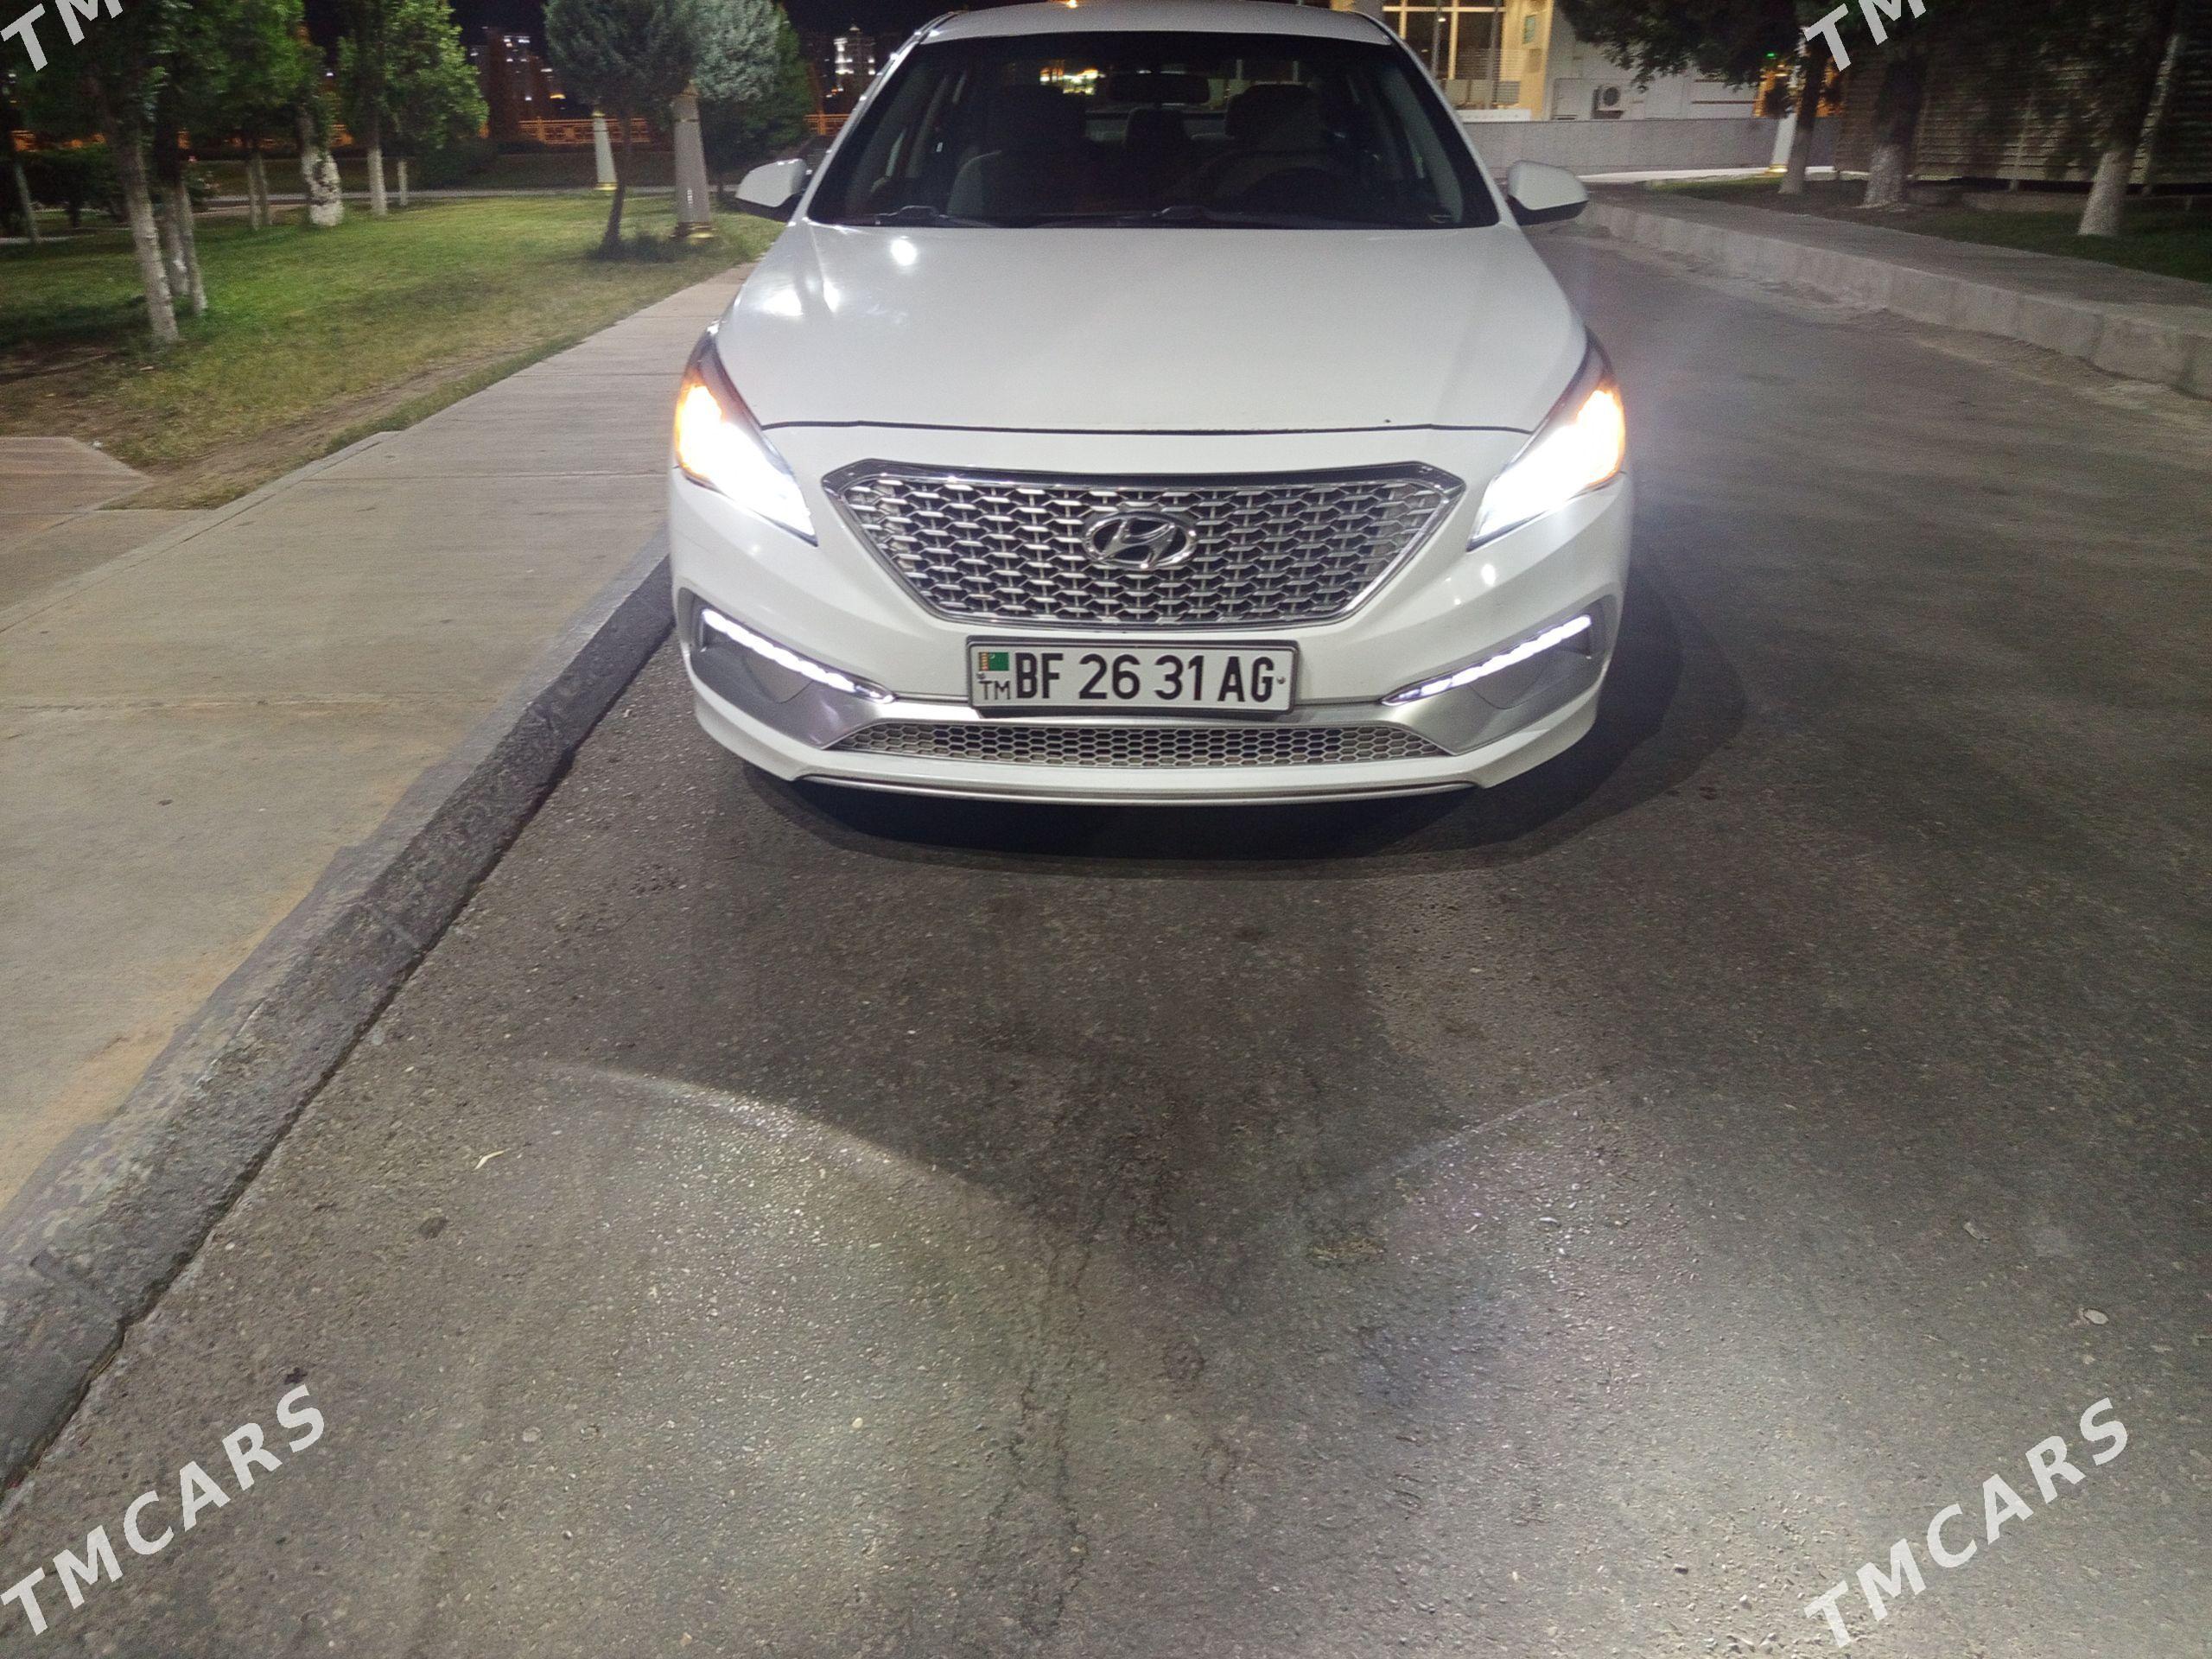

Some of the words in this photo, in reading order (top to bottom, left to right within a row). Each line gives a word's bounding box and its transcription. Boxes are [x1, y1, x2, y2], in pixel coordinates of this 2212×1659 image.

[980, 679, 1011, 700] TM
[1015, 652, 1064, 699] BF
[1078, 654, 1141, 700] 26
[1154, 655, 1205, 701] 31
[1217, 656, 1274, 702] AG
